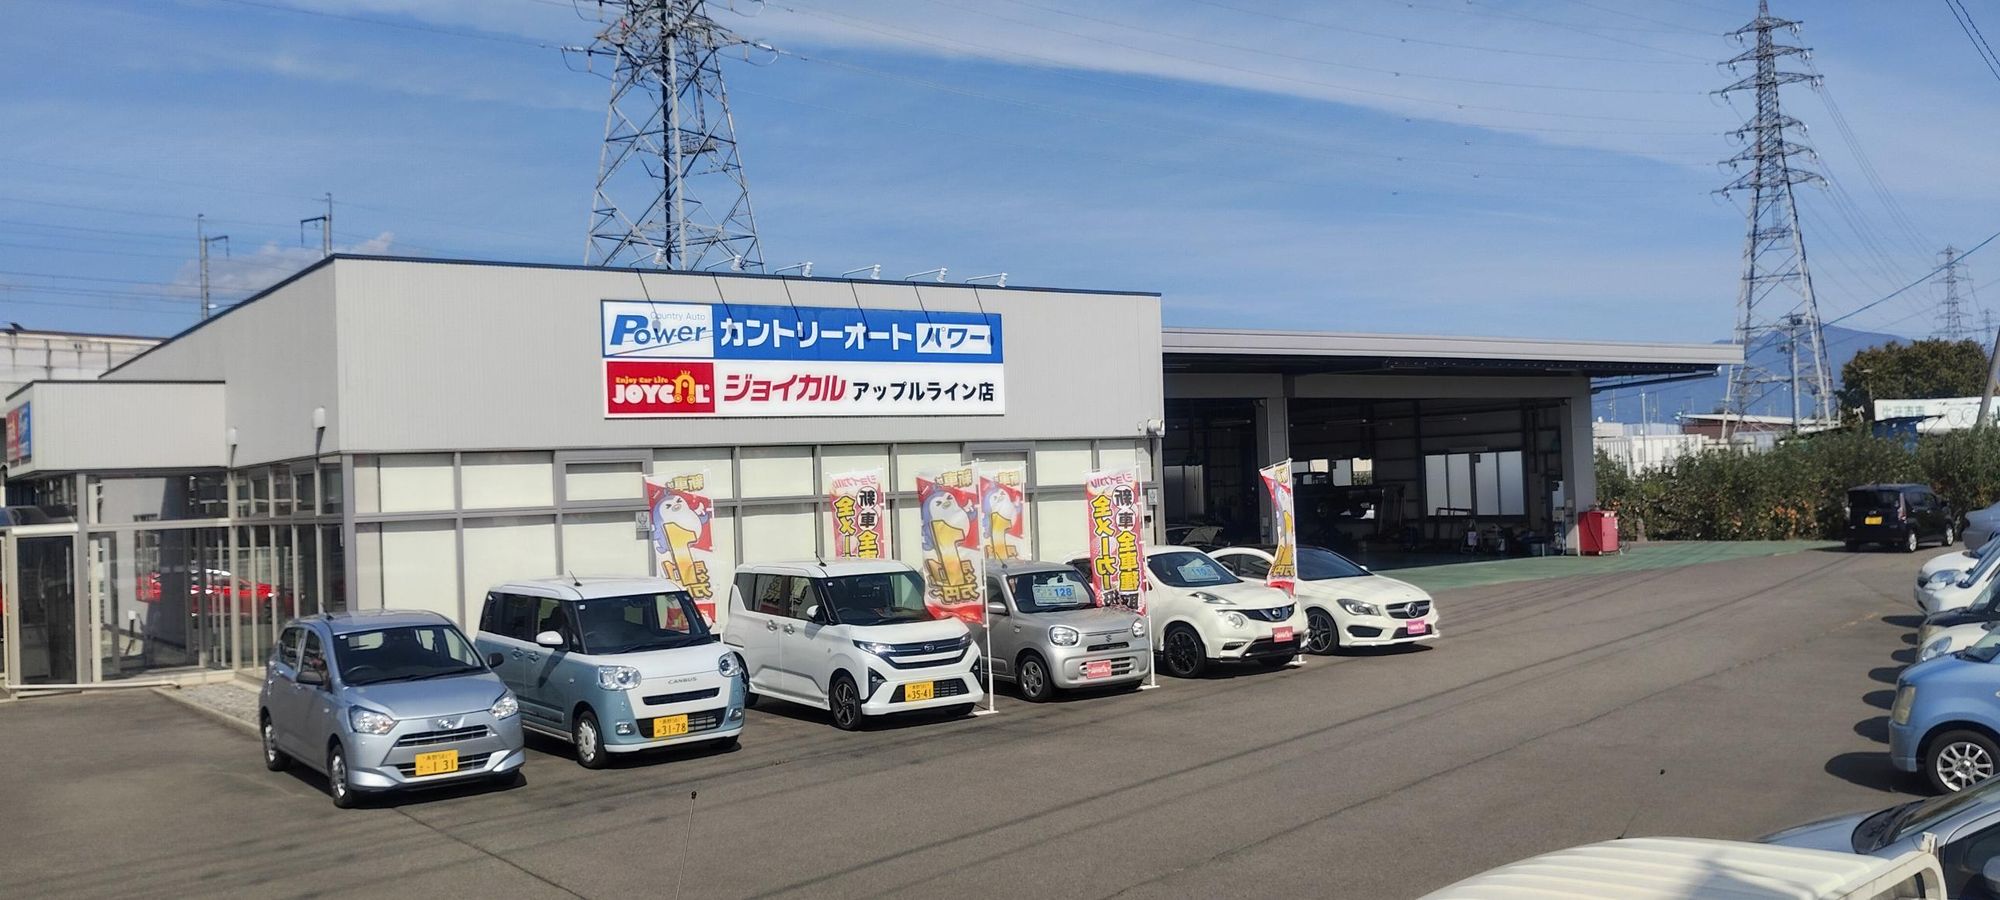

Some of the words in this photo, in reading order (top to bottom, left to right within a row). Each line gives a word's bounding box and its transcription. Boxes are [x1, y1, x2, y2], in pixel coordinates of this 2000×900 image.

[651, 312, 684, 321] Country
[686, 312, 706, 321] Auto
[610, 314, 707, 346] Power
[720, 318, 912, 350] カントリーオート
[921, 326, 986, 349] パワー
[615, 375, 638, 385] Enjoy
[638, 376, 653, 384] Car
[653, 375, 669, 384] Life
[723, 373, 847, 402] ジョイカル
[853, 382, 994, 401] アップルライン店
[1054, 587, 1073, 597] 128
[668, 676, 697, 684] CANBUS
[911, 688, 931, 700] 35-41
[662, 722, 687, 735] 31-78
